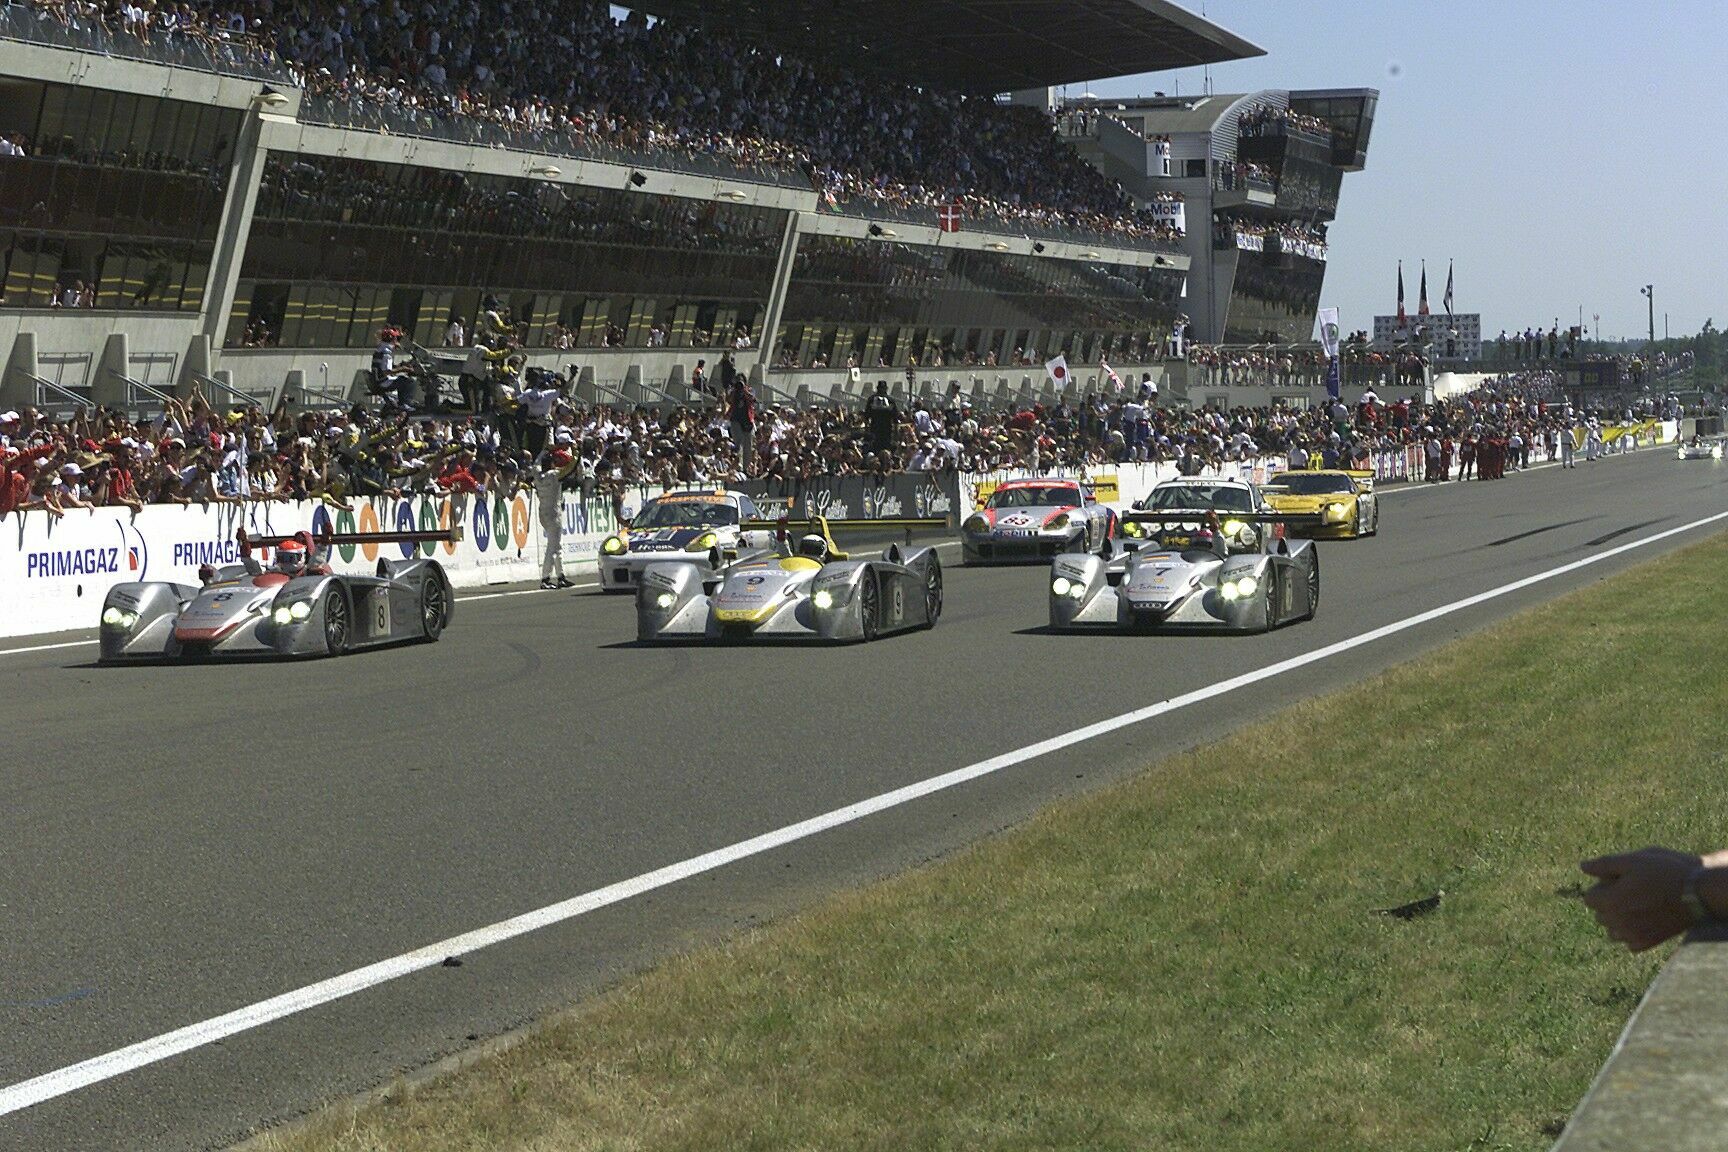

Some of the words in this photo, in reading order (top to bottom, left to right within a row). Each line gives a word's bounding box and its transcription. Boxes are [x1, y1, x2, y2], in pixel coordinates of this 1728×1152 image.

[1003, 515, 1030, 526] 83
[174, 540, 243, 566] PRIMAGA
[27, 548, 119, 578] PRIMAGAZ
[1155, 567, 1172, 576] 7
[747, 576, 765, 585] 9
[213, 592, 234, 602] 8
[378, 605, 385, 629] 8
